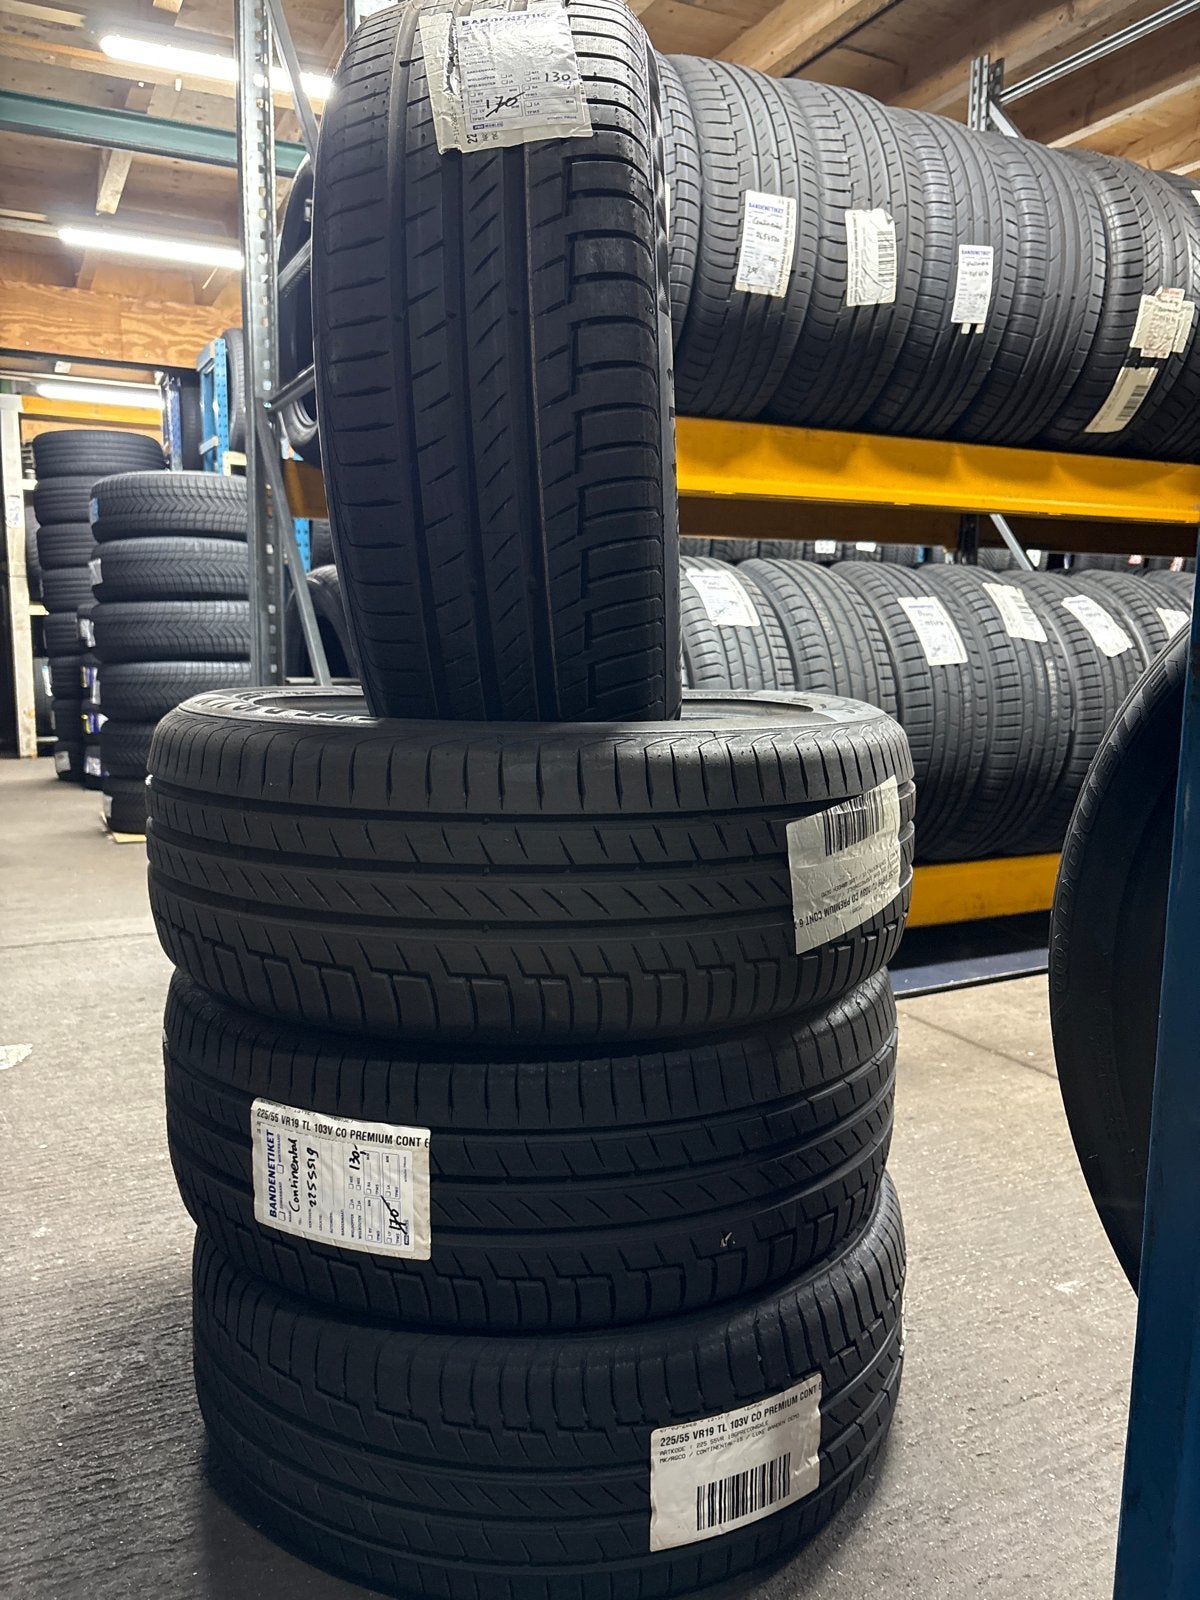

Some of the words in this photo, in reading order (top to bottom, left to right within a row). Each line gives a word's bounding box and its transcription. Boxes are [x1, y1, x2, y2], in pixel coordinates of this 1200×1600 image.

[805, 911, 823, 926] CONT
[256, 1107, 279, 1123] 225/55
[281, 1117, 300, 1129] VR19
[302, 1120, 311, 1131] TL
[314, 1123, 333, 1136] 103V
[335, 1127, 347, 1138] CO
[350, 1129, 393, 1145] PREMIUM
[396, 1136, 422, 1147] CONT
[266, 1129, 278, 1218] BANDENETIKET
[660, 1433, 690, 1447] 225/55
[692, 1428, 715, 1441] VR19
[717, 1423, 727, 1434] TL
[730, 1416, 749, 1430] 103V
[751, 1411, 762, 1422] CO
[763, 1396, 798, 1418] PREMIUM
[799, 1385, 817, 1401] CONT
